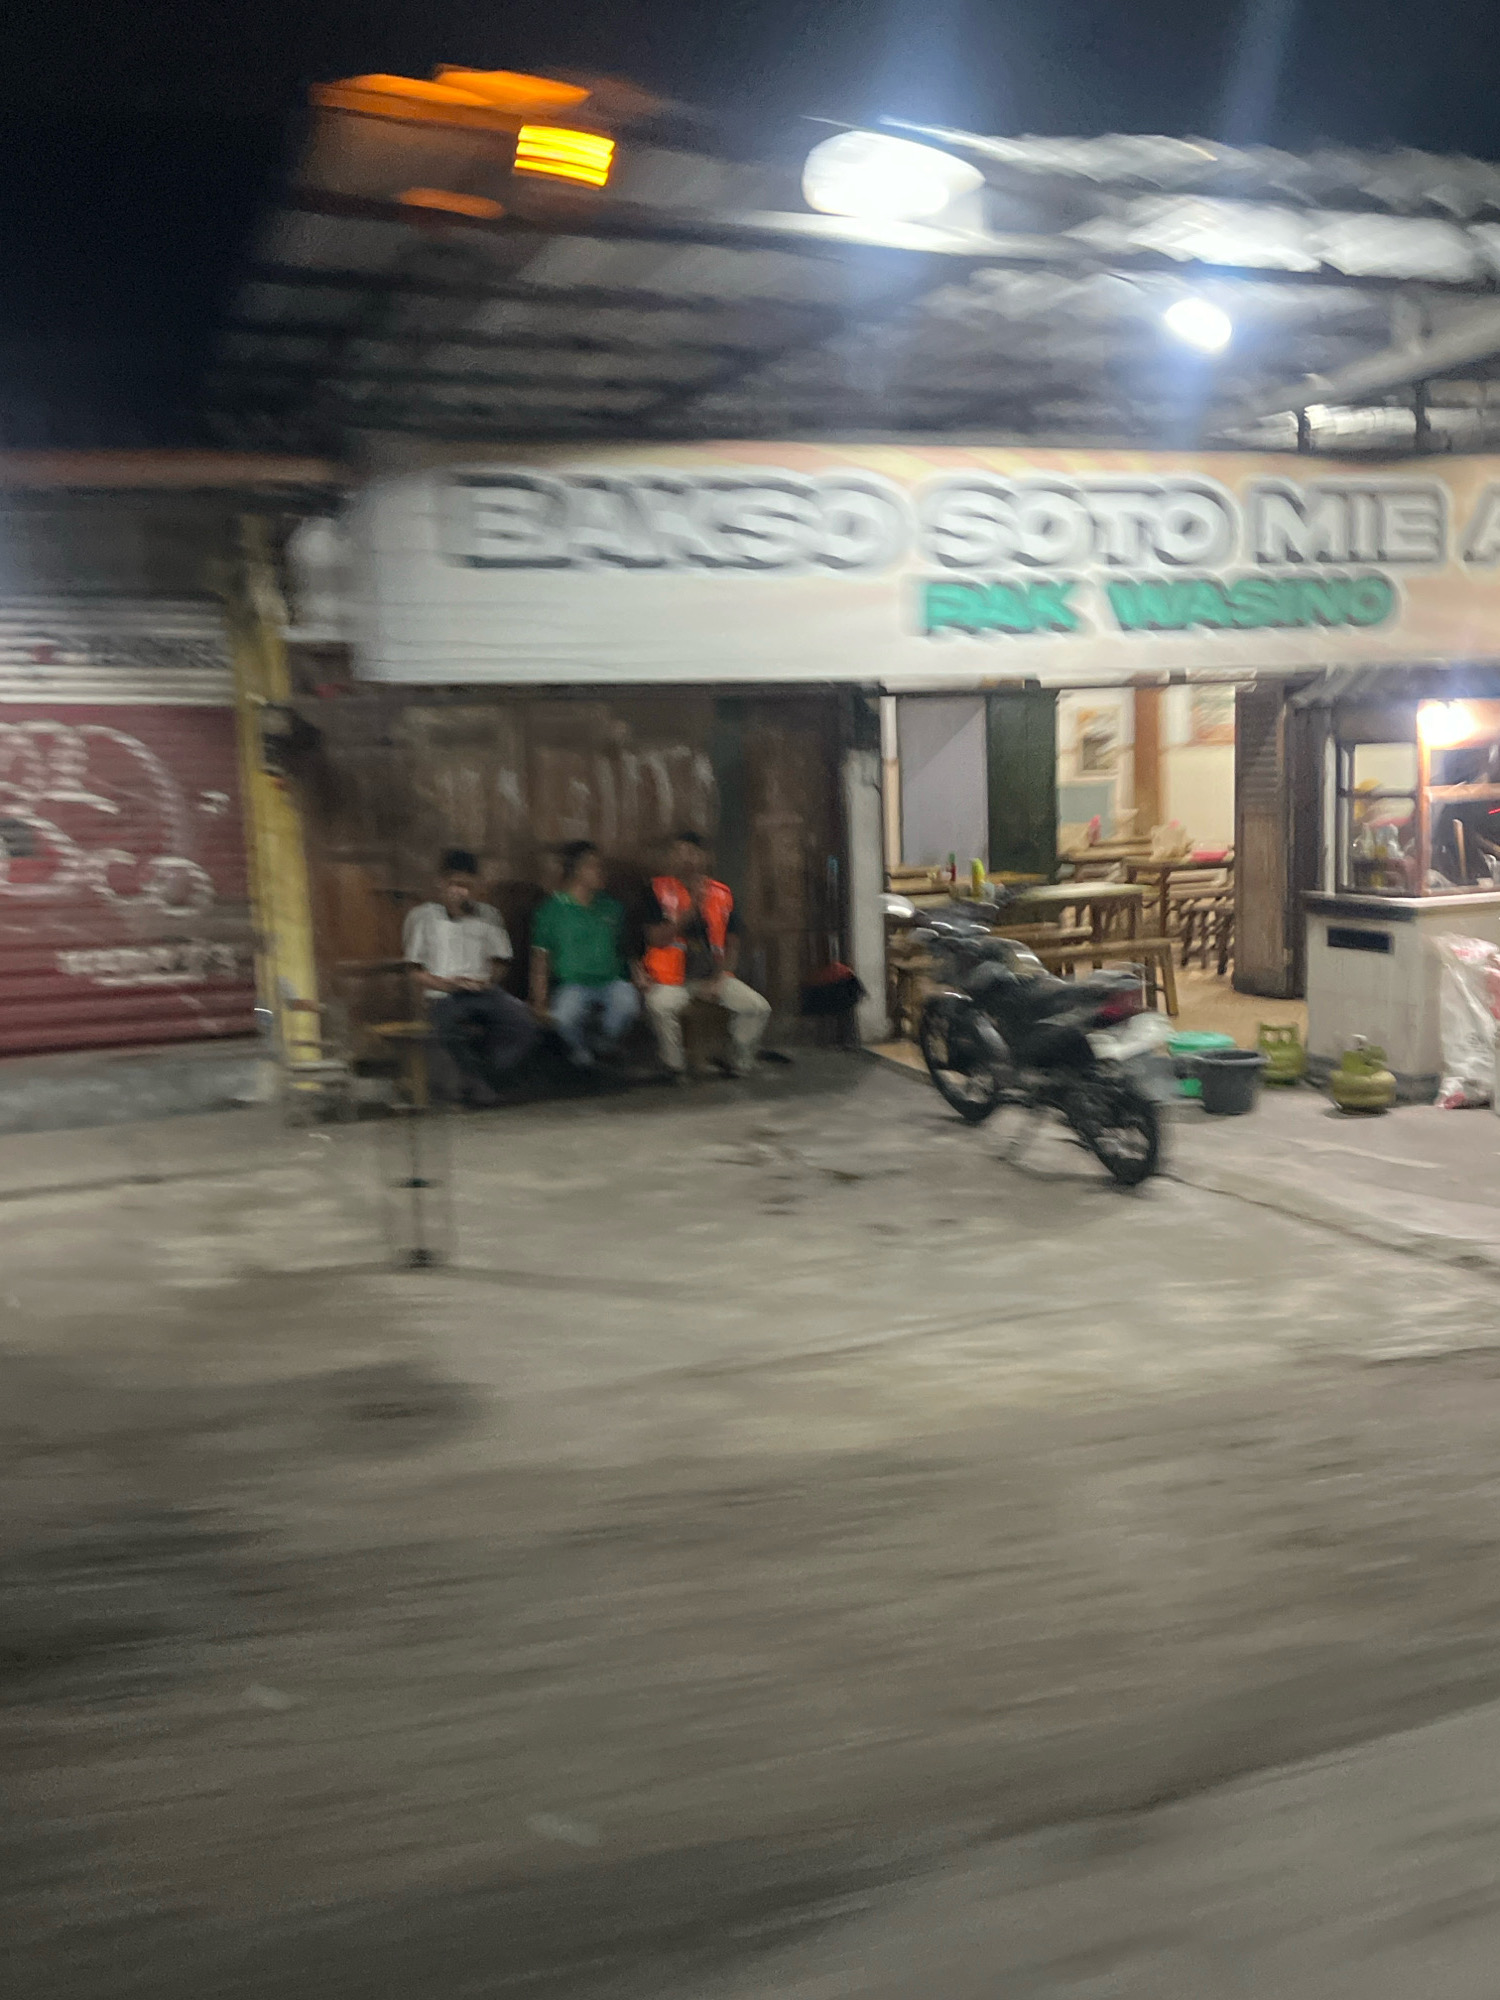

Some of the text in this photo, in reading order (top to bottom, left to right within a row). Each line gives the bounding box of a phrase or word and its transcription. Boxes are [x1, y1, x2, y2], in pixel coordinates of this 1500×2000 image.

[447, 470, 900, 570] BAKSO
[924, 478, 1232, 567] SOTO
[1252, 480, 1441, 564] MIE
[922, 576, 1396, 635] PAK WASINO
